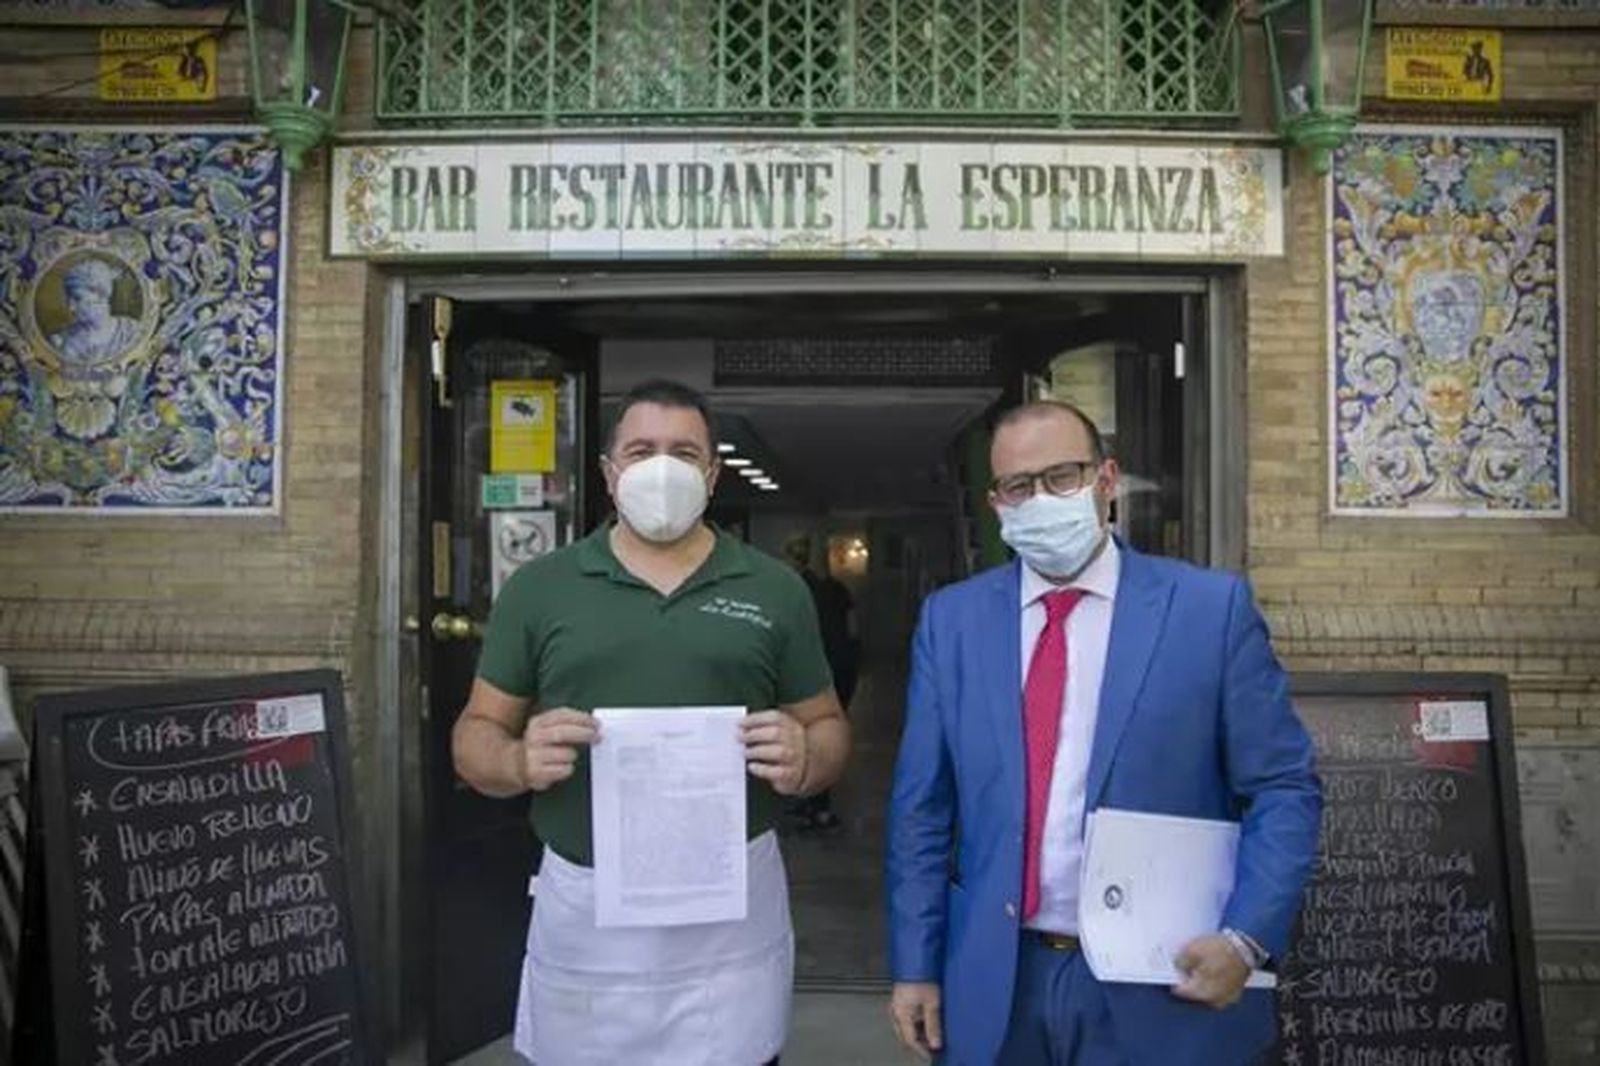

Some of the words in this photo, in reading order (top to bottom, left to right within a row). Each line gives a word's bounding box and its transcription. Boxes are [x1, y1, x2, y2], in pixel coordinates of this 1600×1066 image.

[391, 164, 477, 233] BAR
[509, 161, 833, 232] RESTAURANTE
[866, 162, 928, 231] LA
[960, 163, 1225, 234] ESPERANZA
